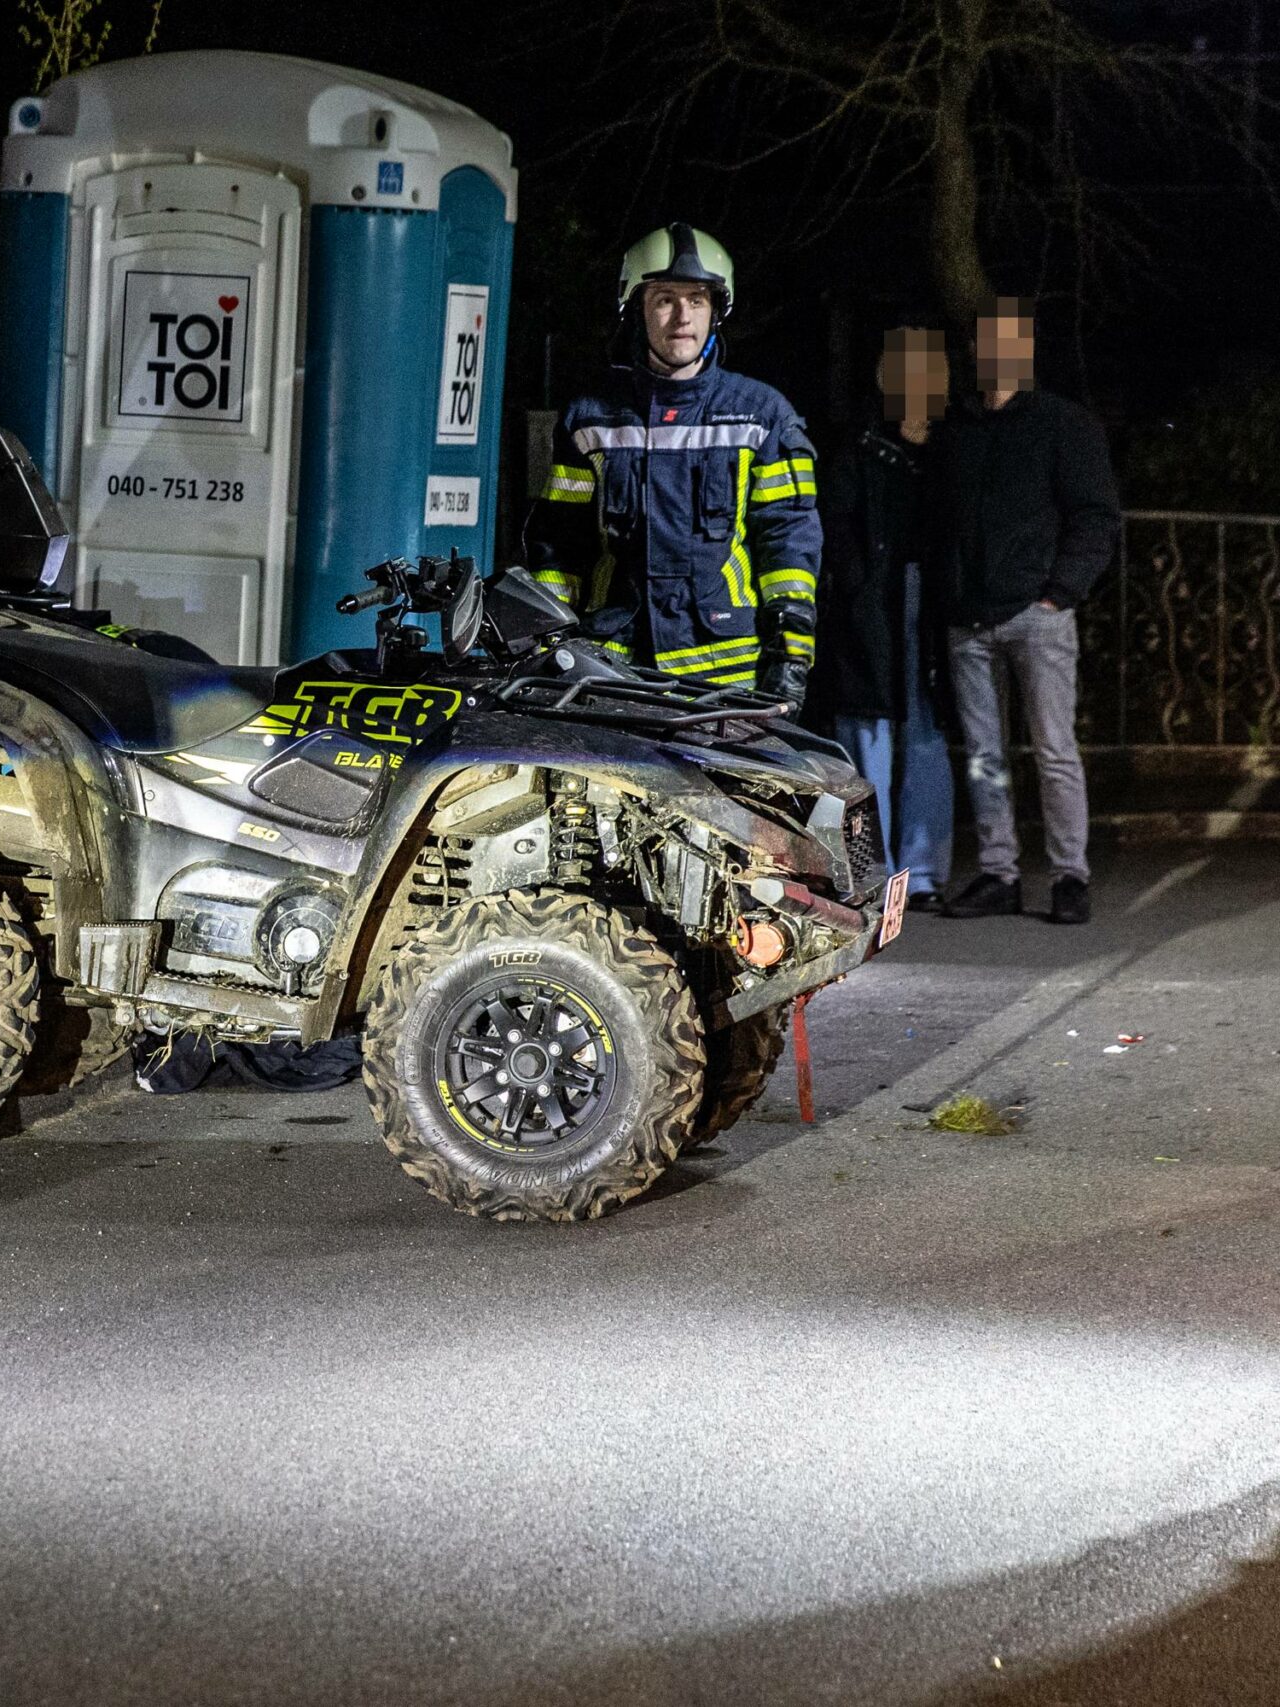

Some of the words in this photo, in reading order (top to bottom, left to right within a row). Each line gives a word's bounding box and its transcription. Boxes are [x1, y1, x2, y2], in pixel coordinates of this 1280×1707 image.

[149, 313, 234, 361] TOI
[457, 333, 479, 377] TOI
[147, 361, 230, 410] TOI
[450, 382, 475, 425] TOI
[107, 475, 145, 497] 040
[162, 477, 199, 500] 751
[206, 480, 245, 502] 238
[488, 950, 542, 968] TGB
[486, 1152, 584, 1189] KENDA
